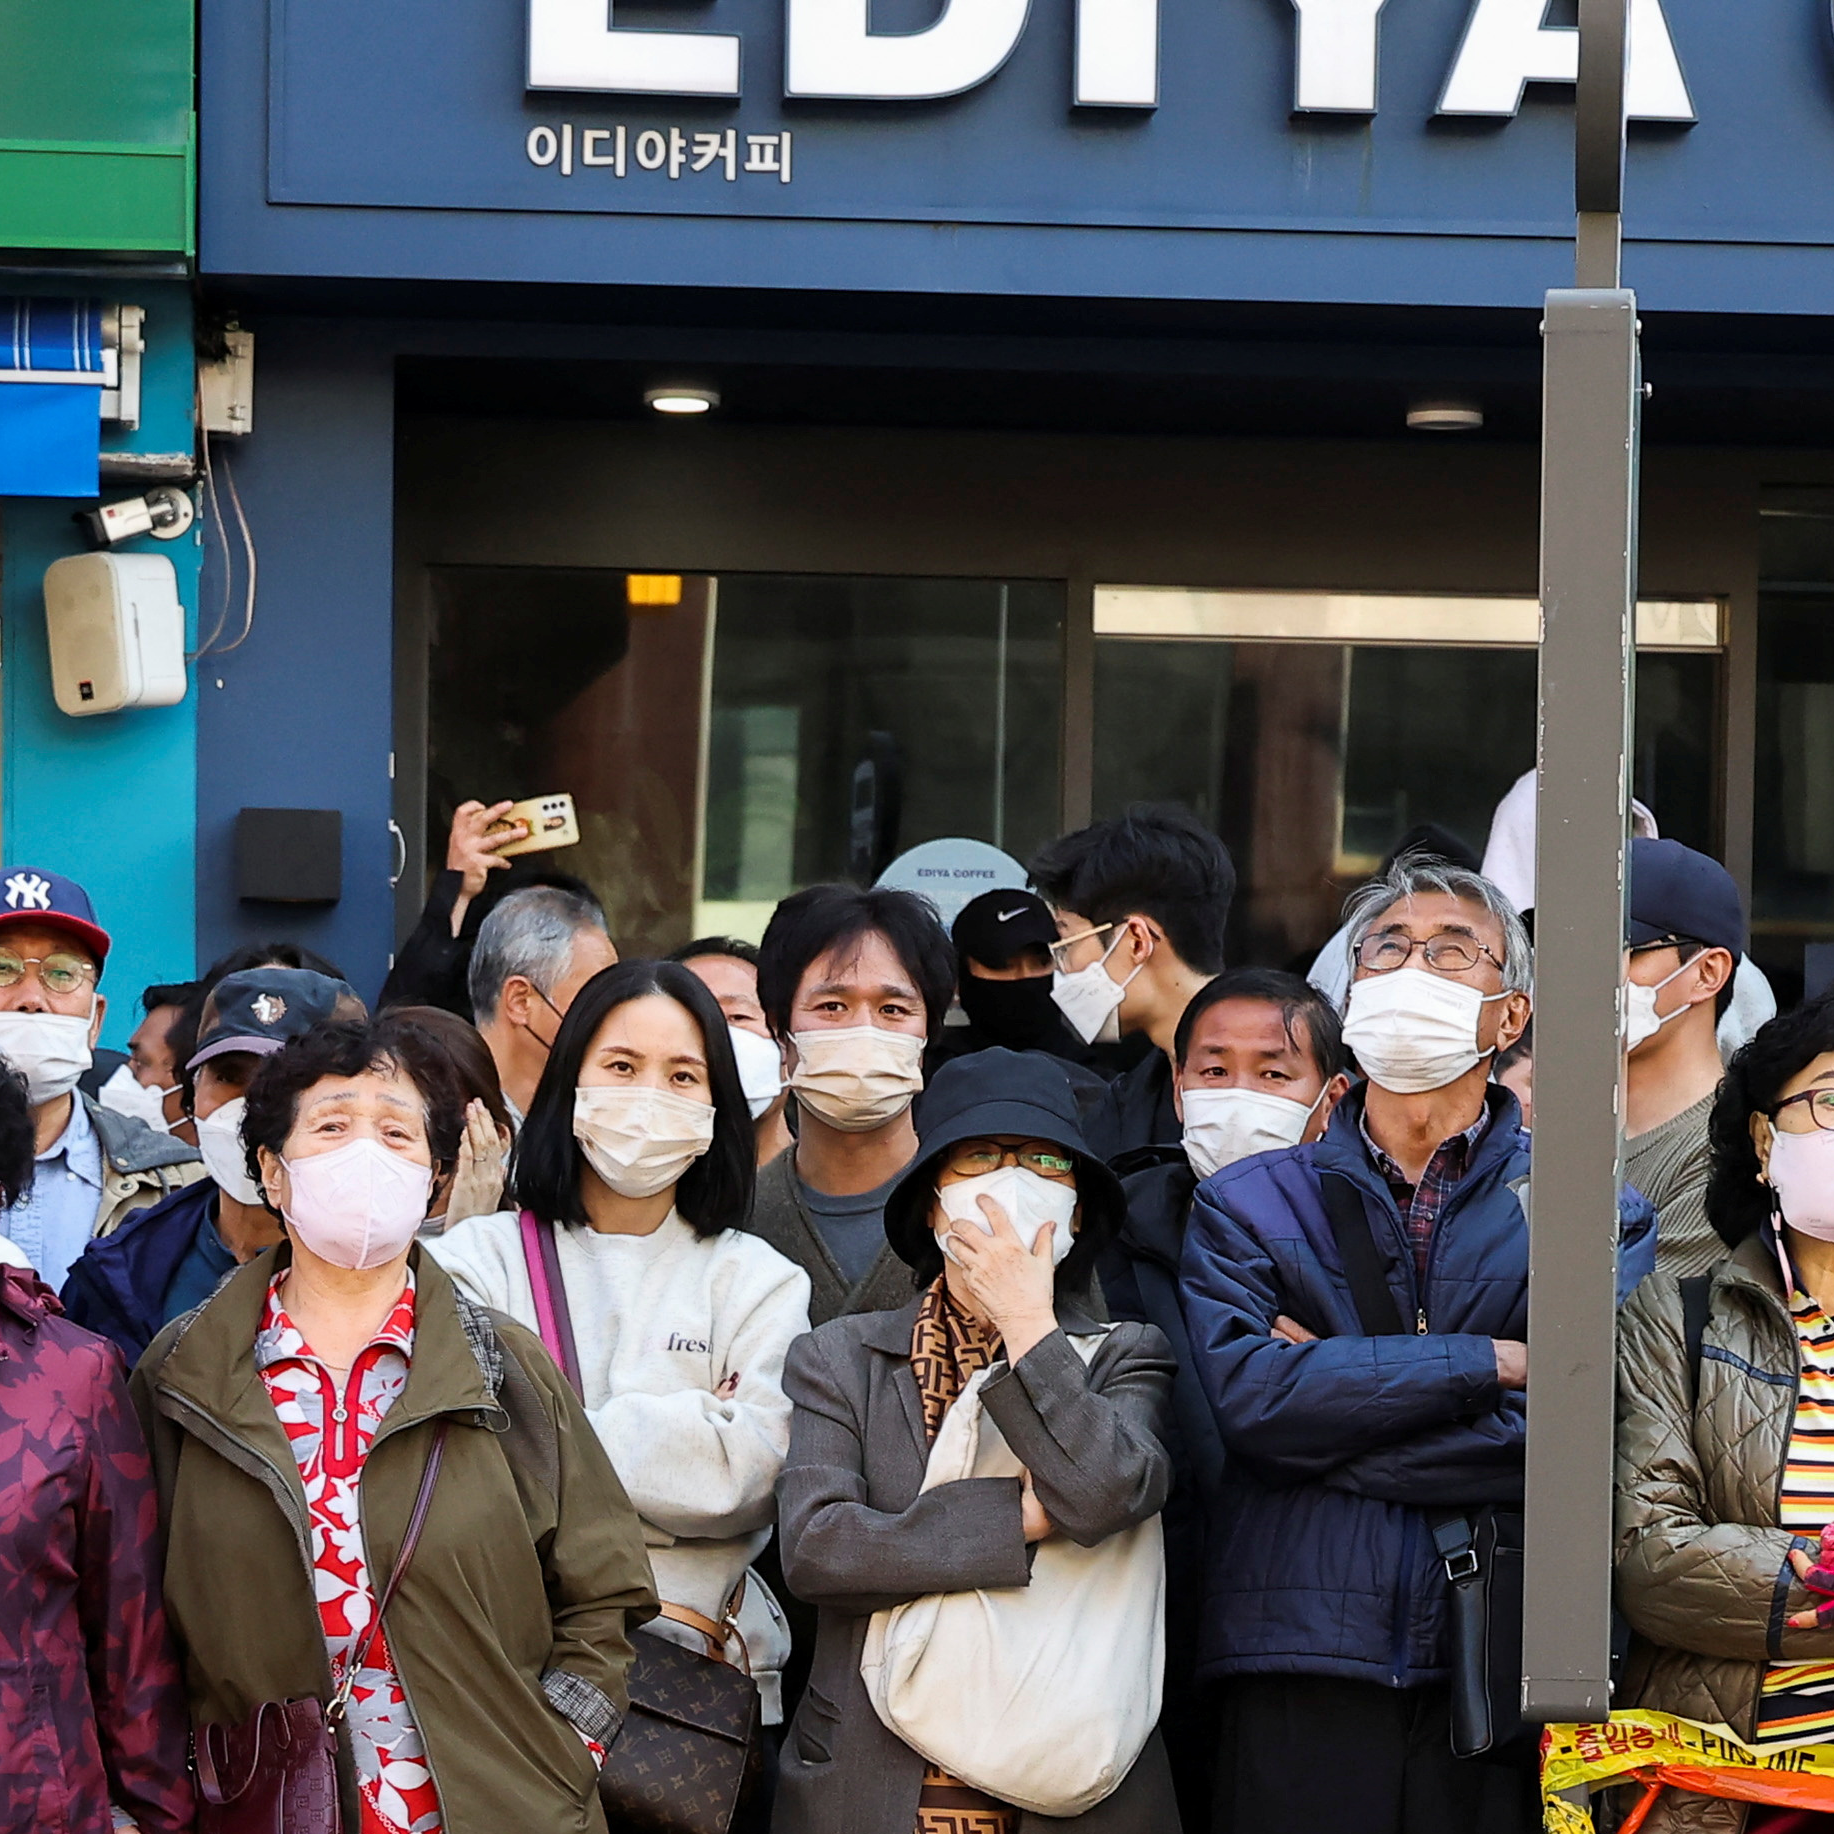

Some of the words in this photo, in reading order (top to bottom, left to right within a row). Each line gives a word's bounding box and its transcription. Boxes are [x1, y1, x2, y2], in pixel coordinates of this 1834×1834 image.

[525, 125, 794, 184] 이디야커피
[4, 872, 51, 911] NY
[917, 868, 950, 878] EDIYA
[953, 869, 996, 879] COFFEE
